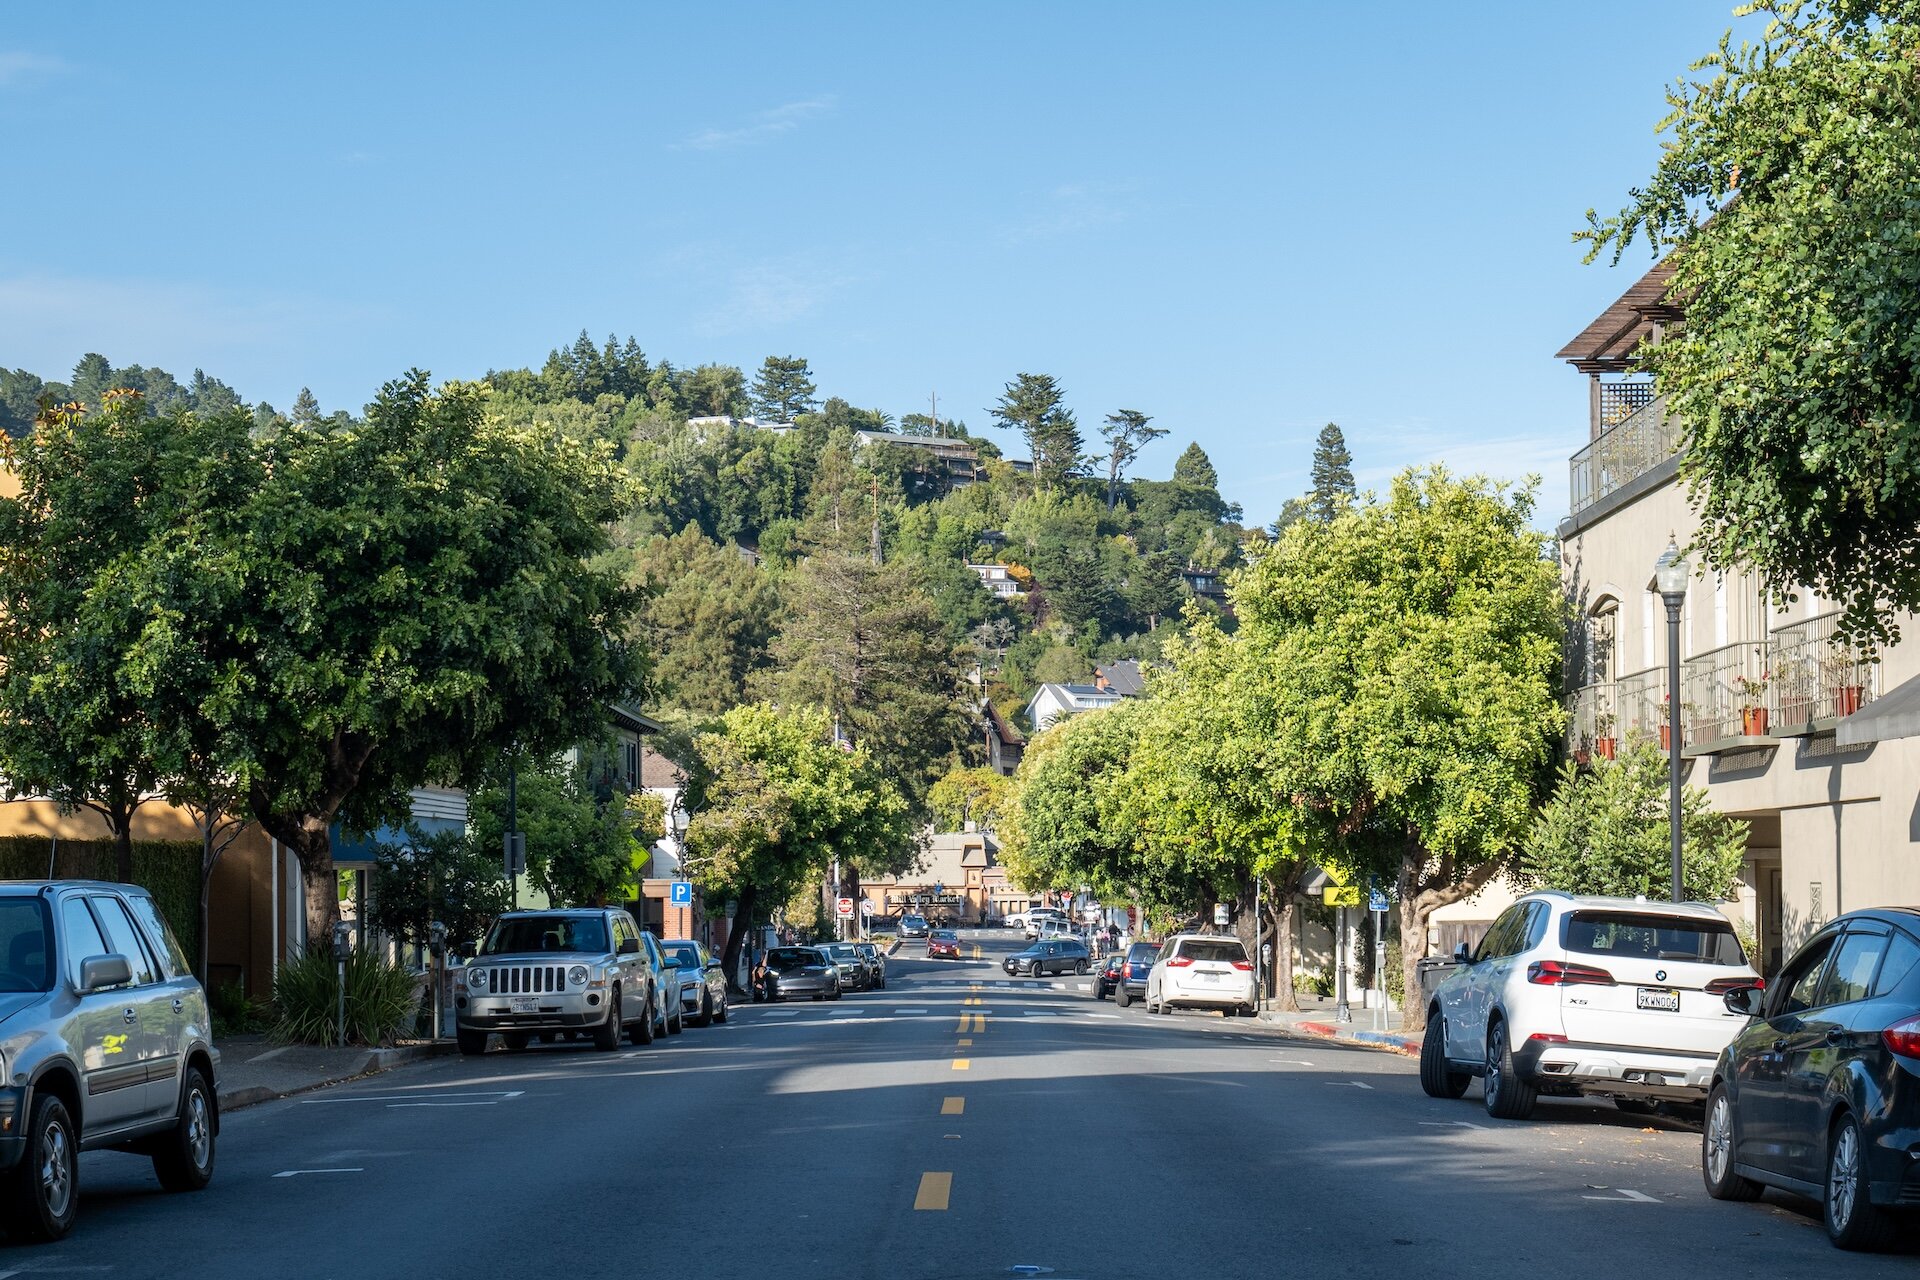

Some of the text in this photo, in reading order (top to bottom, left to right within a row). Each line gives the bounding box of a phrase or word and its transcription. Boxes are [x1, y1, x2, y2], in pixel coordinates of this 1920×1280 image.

[676, 885, 686, 901] P
[890, 894, 960, 906] Mill Valey Market
[1640, 995, 1677, 1008] 9KWN006
